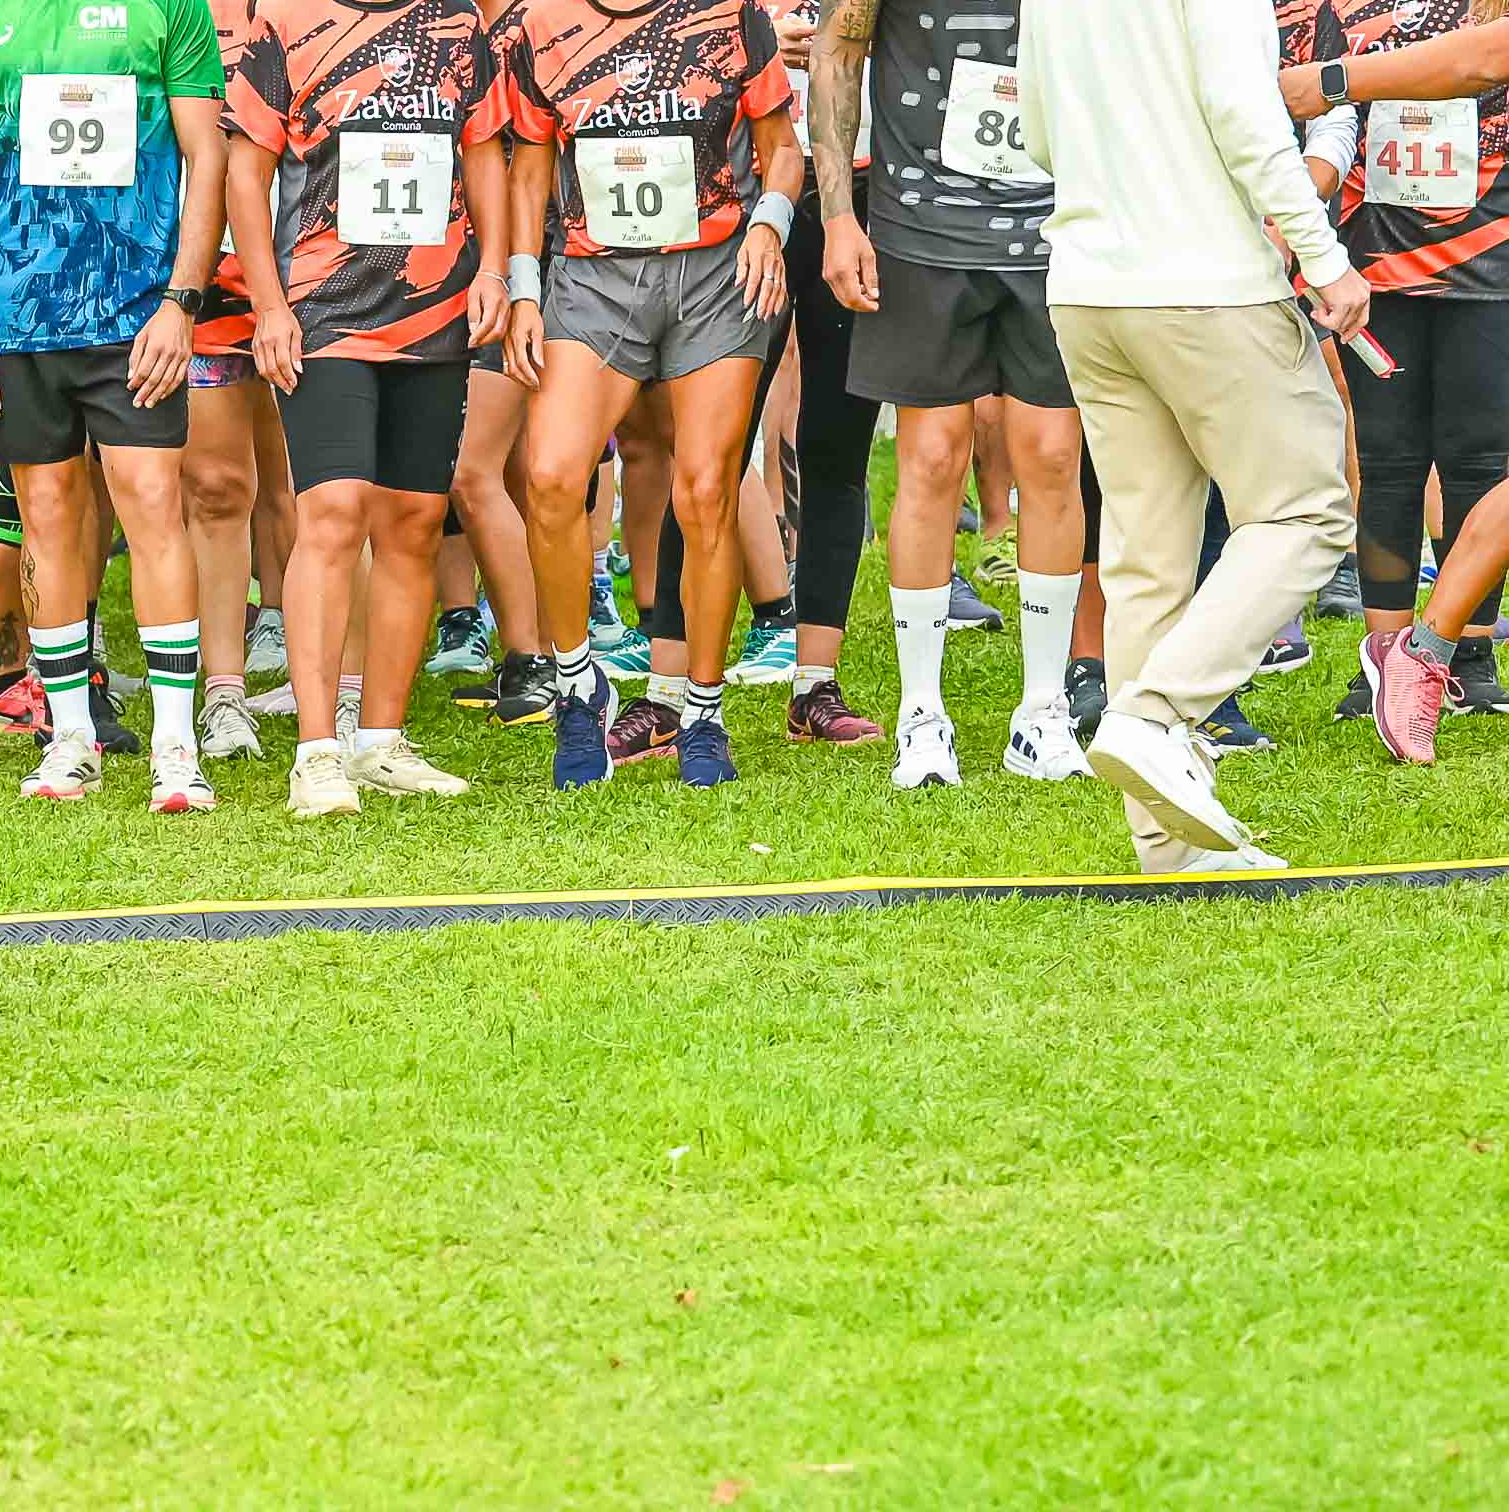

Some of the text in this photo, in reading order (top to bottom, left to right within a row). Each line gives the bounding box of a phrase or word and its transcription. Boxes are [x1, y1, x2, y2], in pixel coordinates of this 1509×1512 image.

[79, 6, 128, 29] CM
[335, 85, 455, 123] Zavalla
[572, 88, 704, 131] Zavalla
[48, 118, 105, 155] 99
[381, 120, 422, 131] Comuna
[617, 128, 660, 138] Comuna
[974, 109, 1025, 151] 86
[981, 159, 1013, 175] Zavalla
[1376, 140, 1458, 177] 411
[372, 178, 423, 215] 11
[608, 181, 663, 217] 10
[1399, 192, 1430, 202] Zavalla
[622, 232, 653, 243] Zavalla
